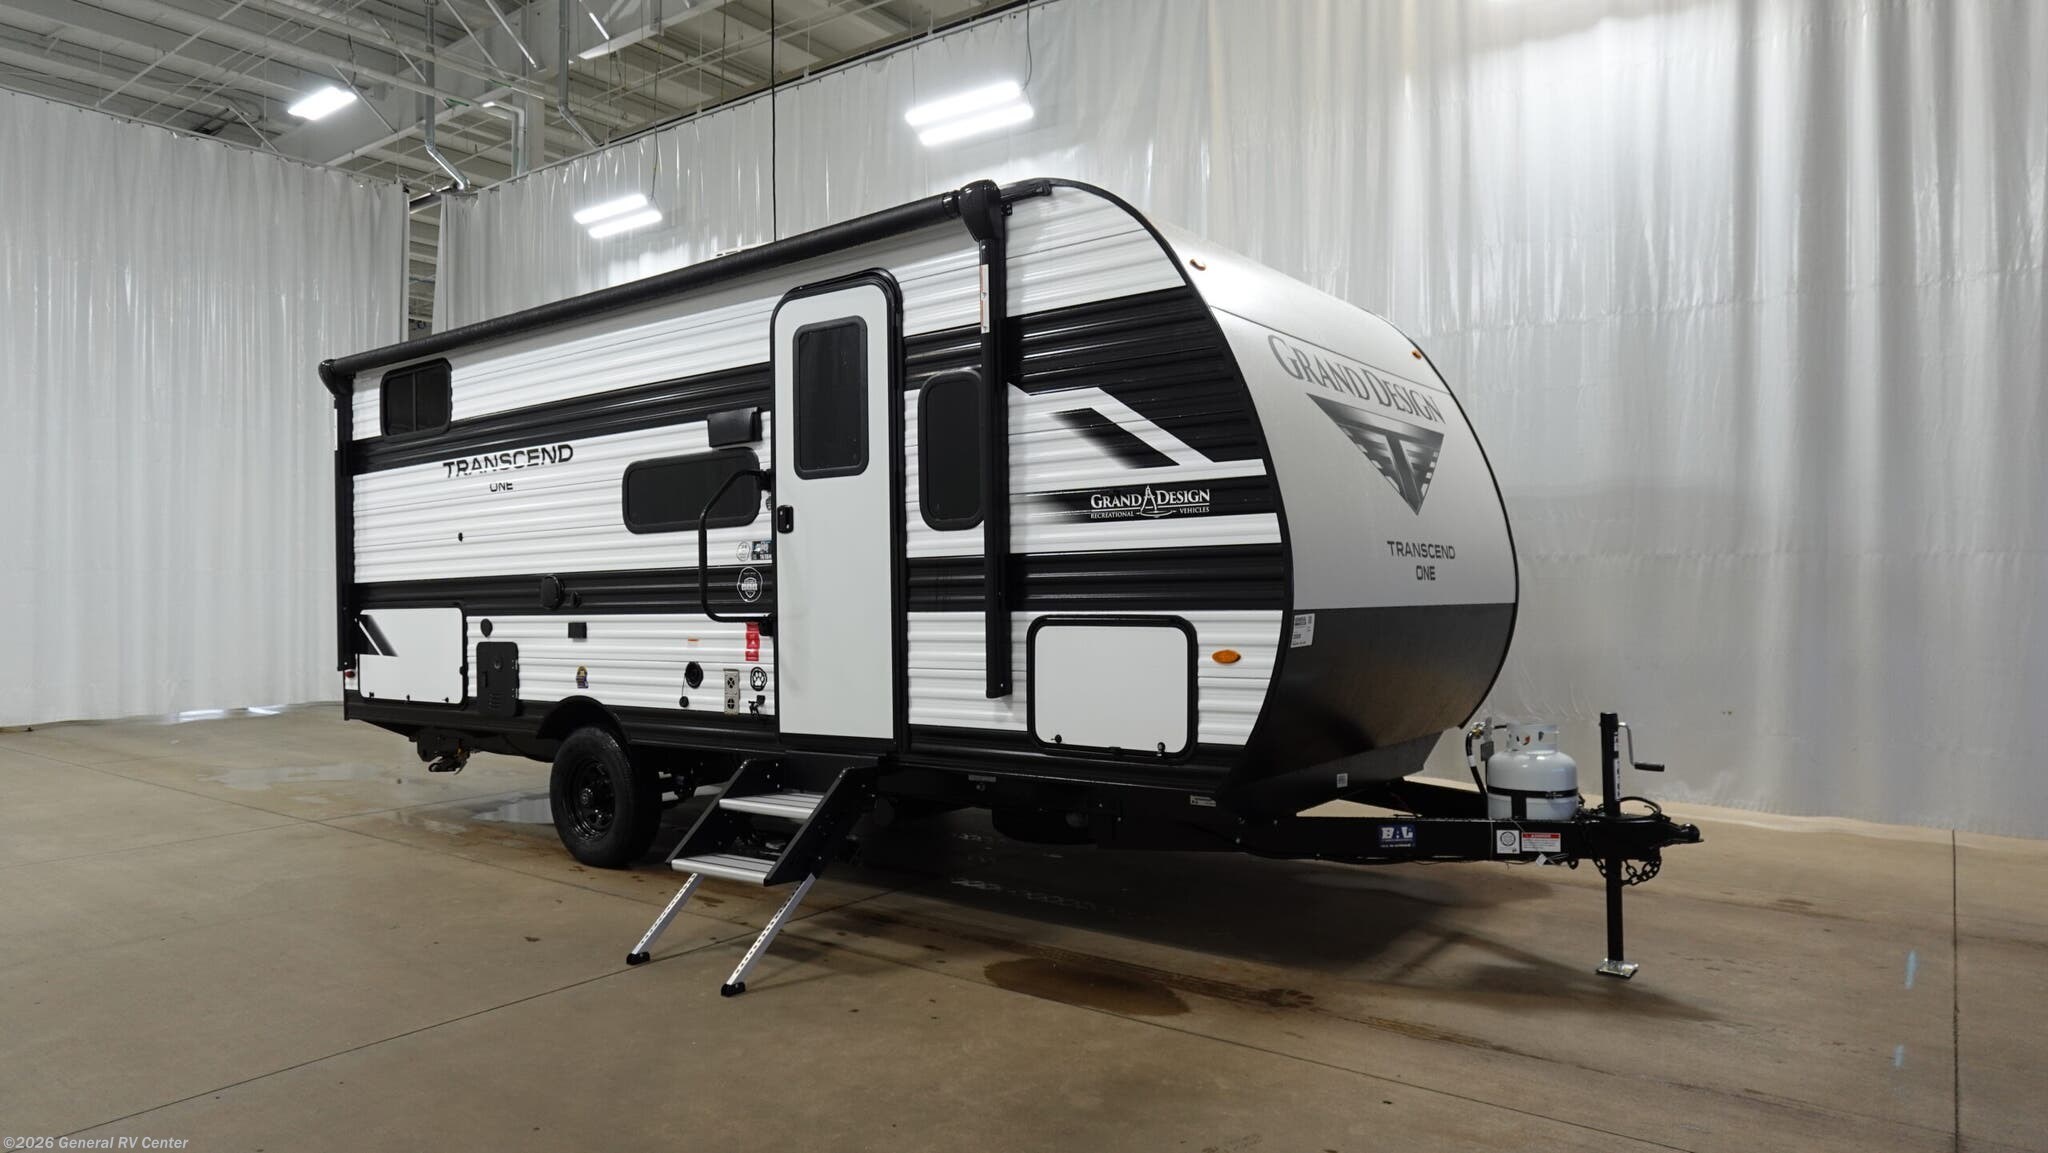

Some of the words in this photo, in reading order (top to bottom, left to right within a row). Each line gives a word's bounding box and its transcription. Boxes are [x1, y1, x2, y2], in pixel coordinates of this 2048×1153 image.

[1267, 334, 1370, 400] GRAND
[1360, 367, 1446, 424] DESIGN
[443, 443, 574, 478] TRANSCEND
[1090, 494, 1142, 509] GRAND
[1155, 488, 1210, 505] DESIGN
[1090, 510, 1135, 519] RECREATIONAL
[1179, 505, 1210, 515] VEHICLES
[1386, 540, 1456, 560] TRANSCEND
[1415, 565, 1436, 581] ONE
